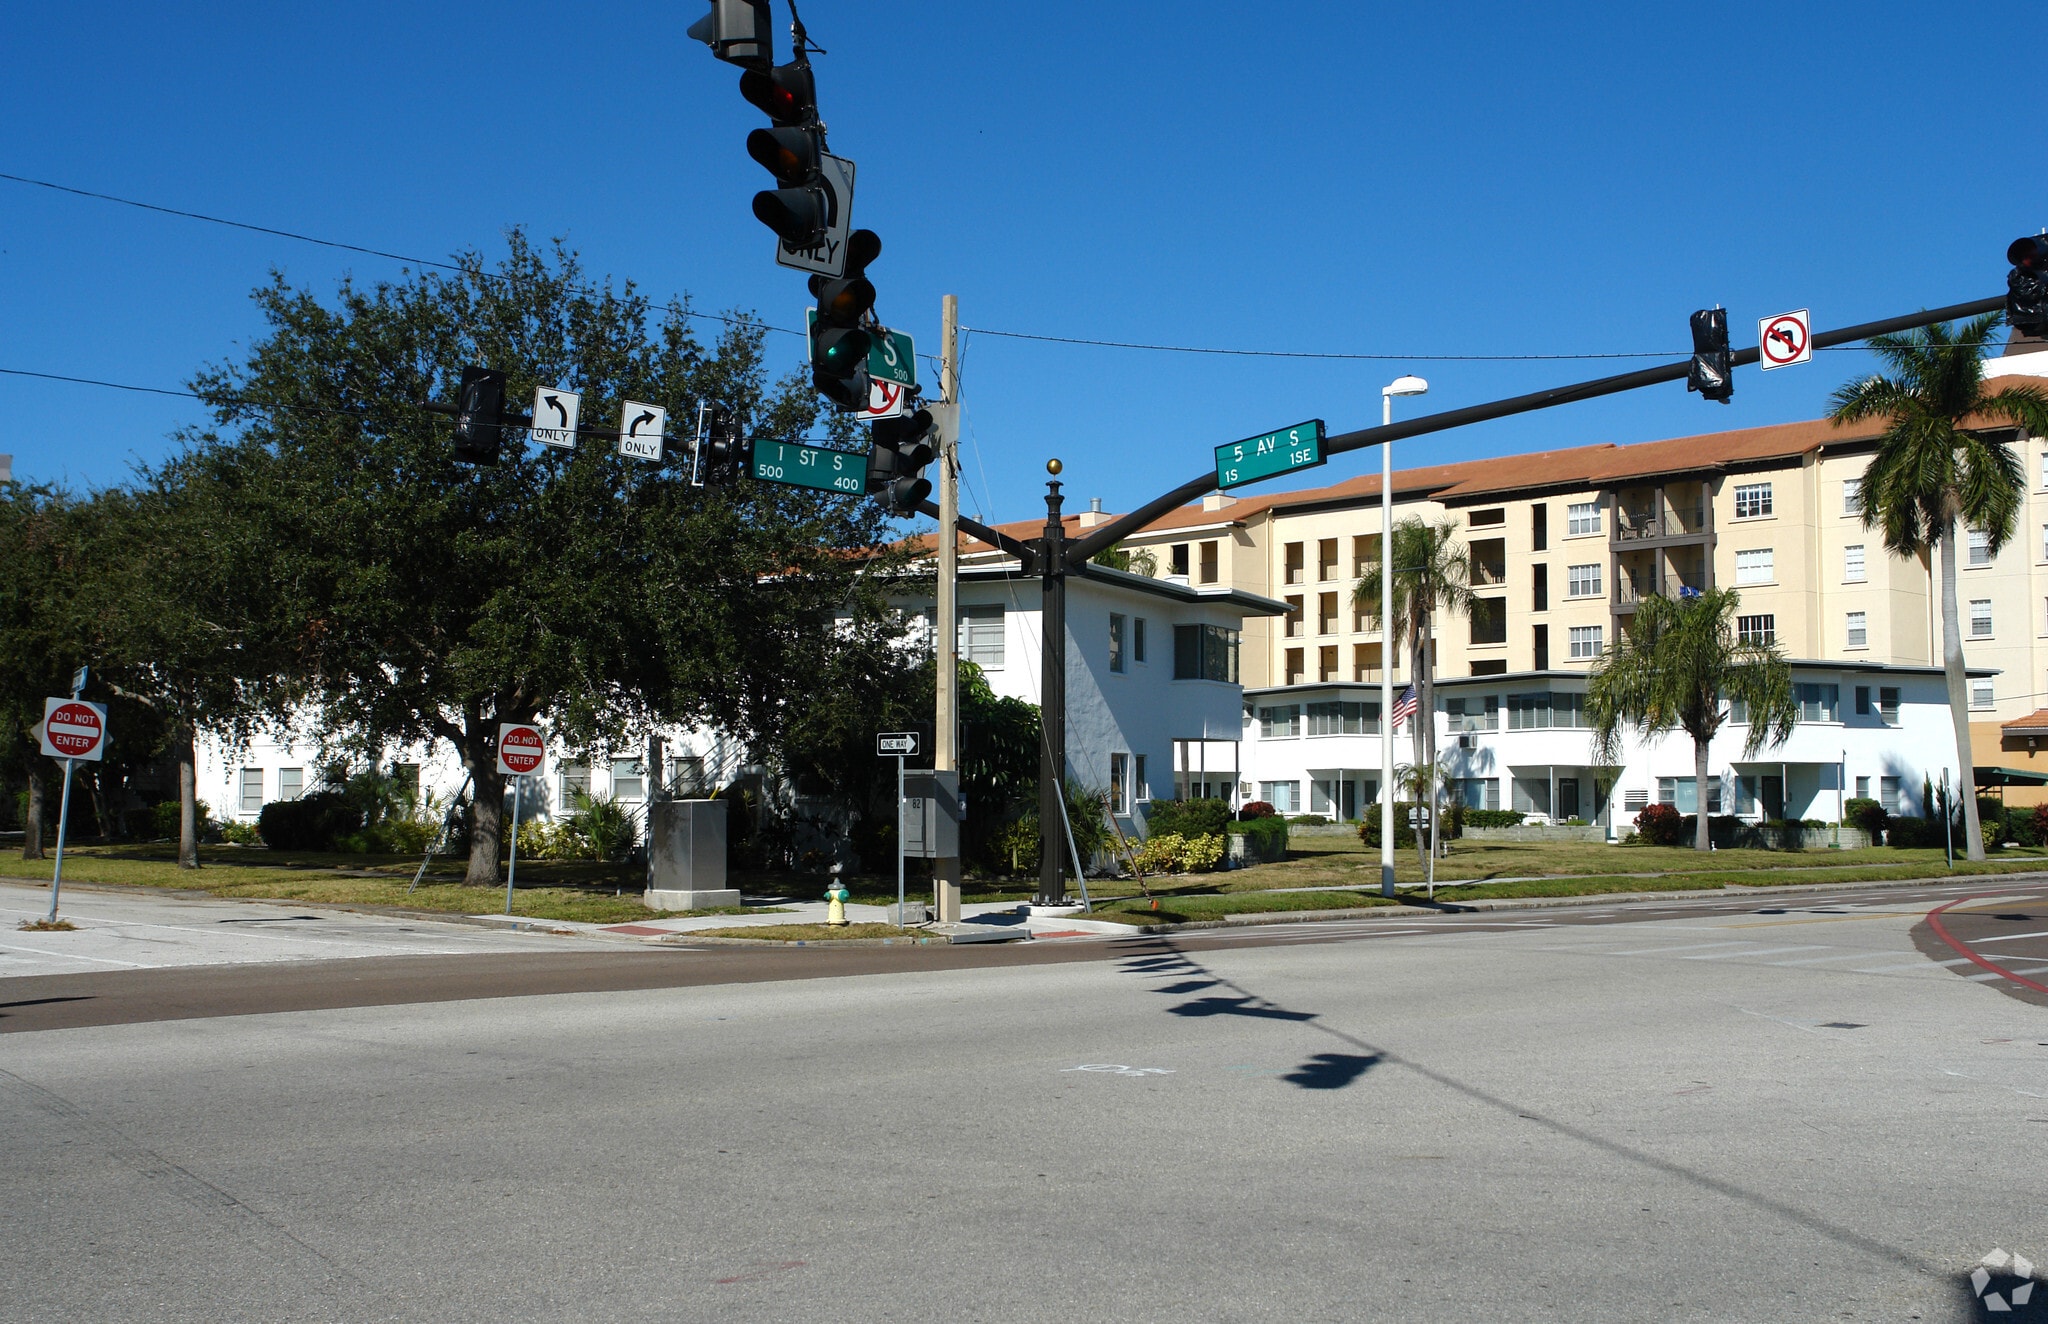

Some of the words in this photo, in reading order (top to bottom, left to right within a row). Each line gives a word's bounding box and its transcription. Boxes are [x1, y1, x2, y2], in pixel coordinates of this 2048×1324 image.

[784, 237, 840, 264] LY
[884, 333, 897, 367] S
[893, 368, 908, 381] 500
[536, 428, 569, 442] ONLY
[625, 441, 657, 455] ONLY
[1234, 445, 1244, 463] 5
[1256, 436, 1275, 457] AV
[1289, 430, 1299, 447] S
[778, 445, 784, 461] 1
[799, 449, 819, 467] ST
[832, 455, 843, 471] S
[1289, 448, 1312, 465] 1SE
[758, 464, 784, 479] 500
[1225, 469, 1239, 483] 1S
[834, 477, 859, 491] 400
[56, 711, 71, 722] DO
[74, 714, 95, 725] NOT
[56, 735, 90, 748] ENTER
[508, 735, 520, 744] DO
[522, 736, 539, 745] NOT
[882, 740, 894, 748] ONE
[895, 740, 907, 748] WAY
[508, 755, 535, 765] ENTER
[912, 798, 921, 809] 82
